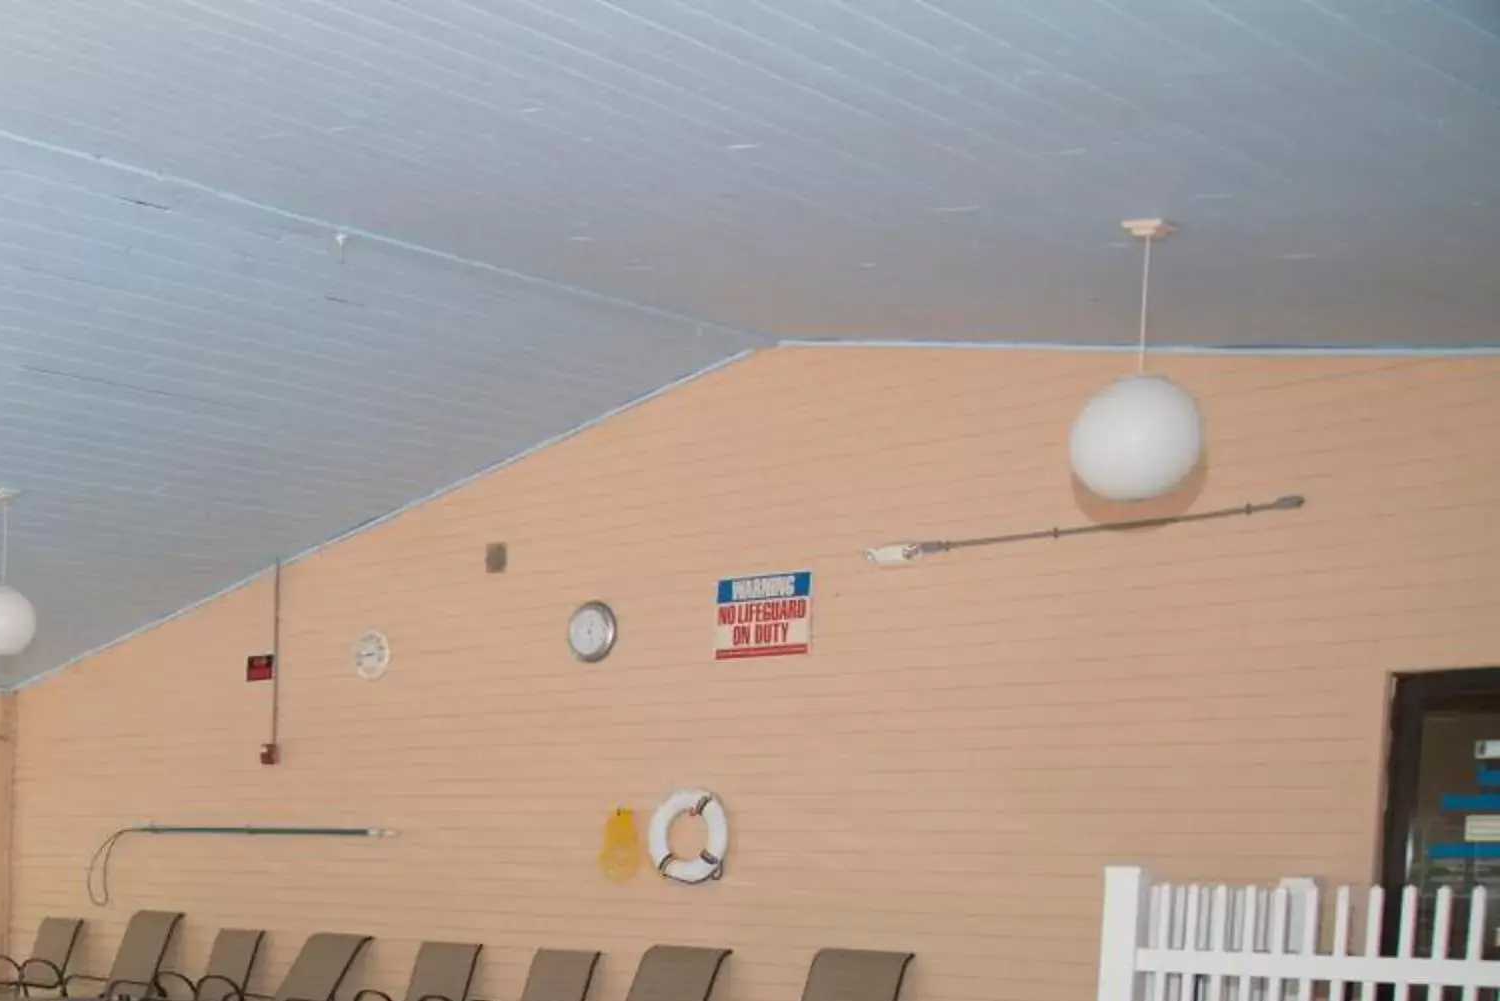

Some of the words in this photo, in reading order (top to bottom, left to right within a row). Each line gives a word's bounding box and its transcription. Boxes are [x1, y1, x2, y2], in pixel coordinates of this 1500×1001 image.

[732, 576, 796, 600] WARNING
[718, 605, 736, 625] NO
[738, 599, 807, 625] LIFEGUARD
[733, 625, 751, 646] ON
[755, 623, 790, 645] DUTY
